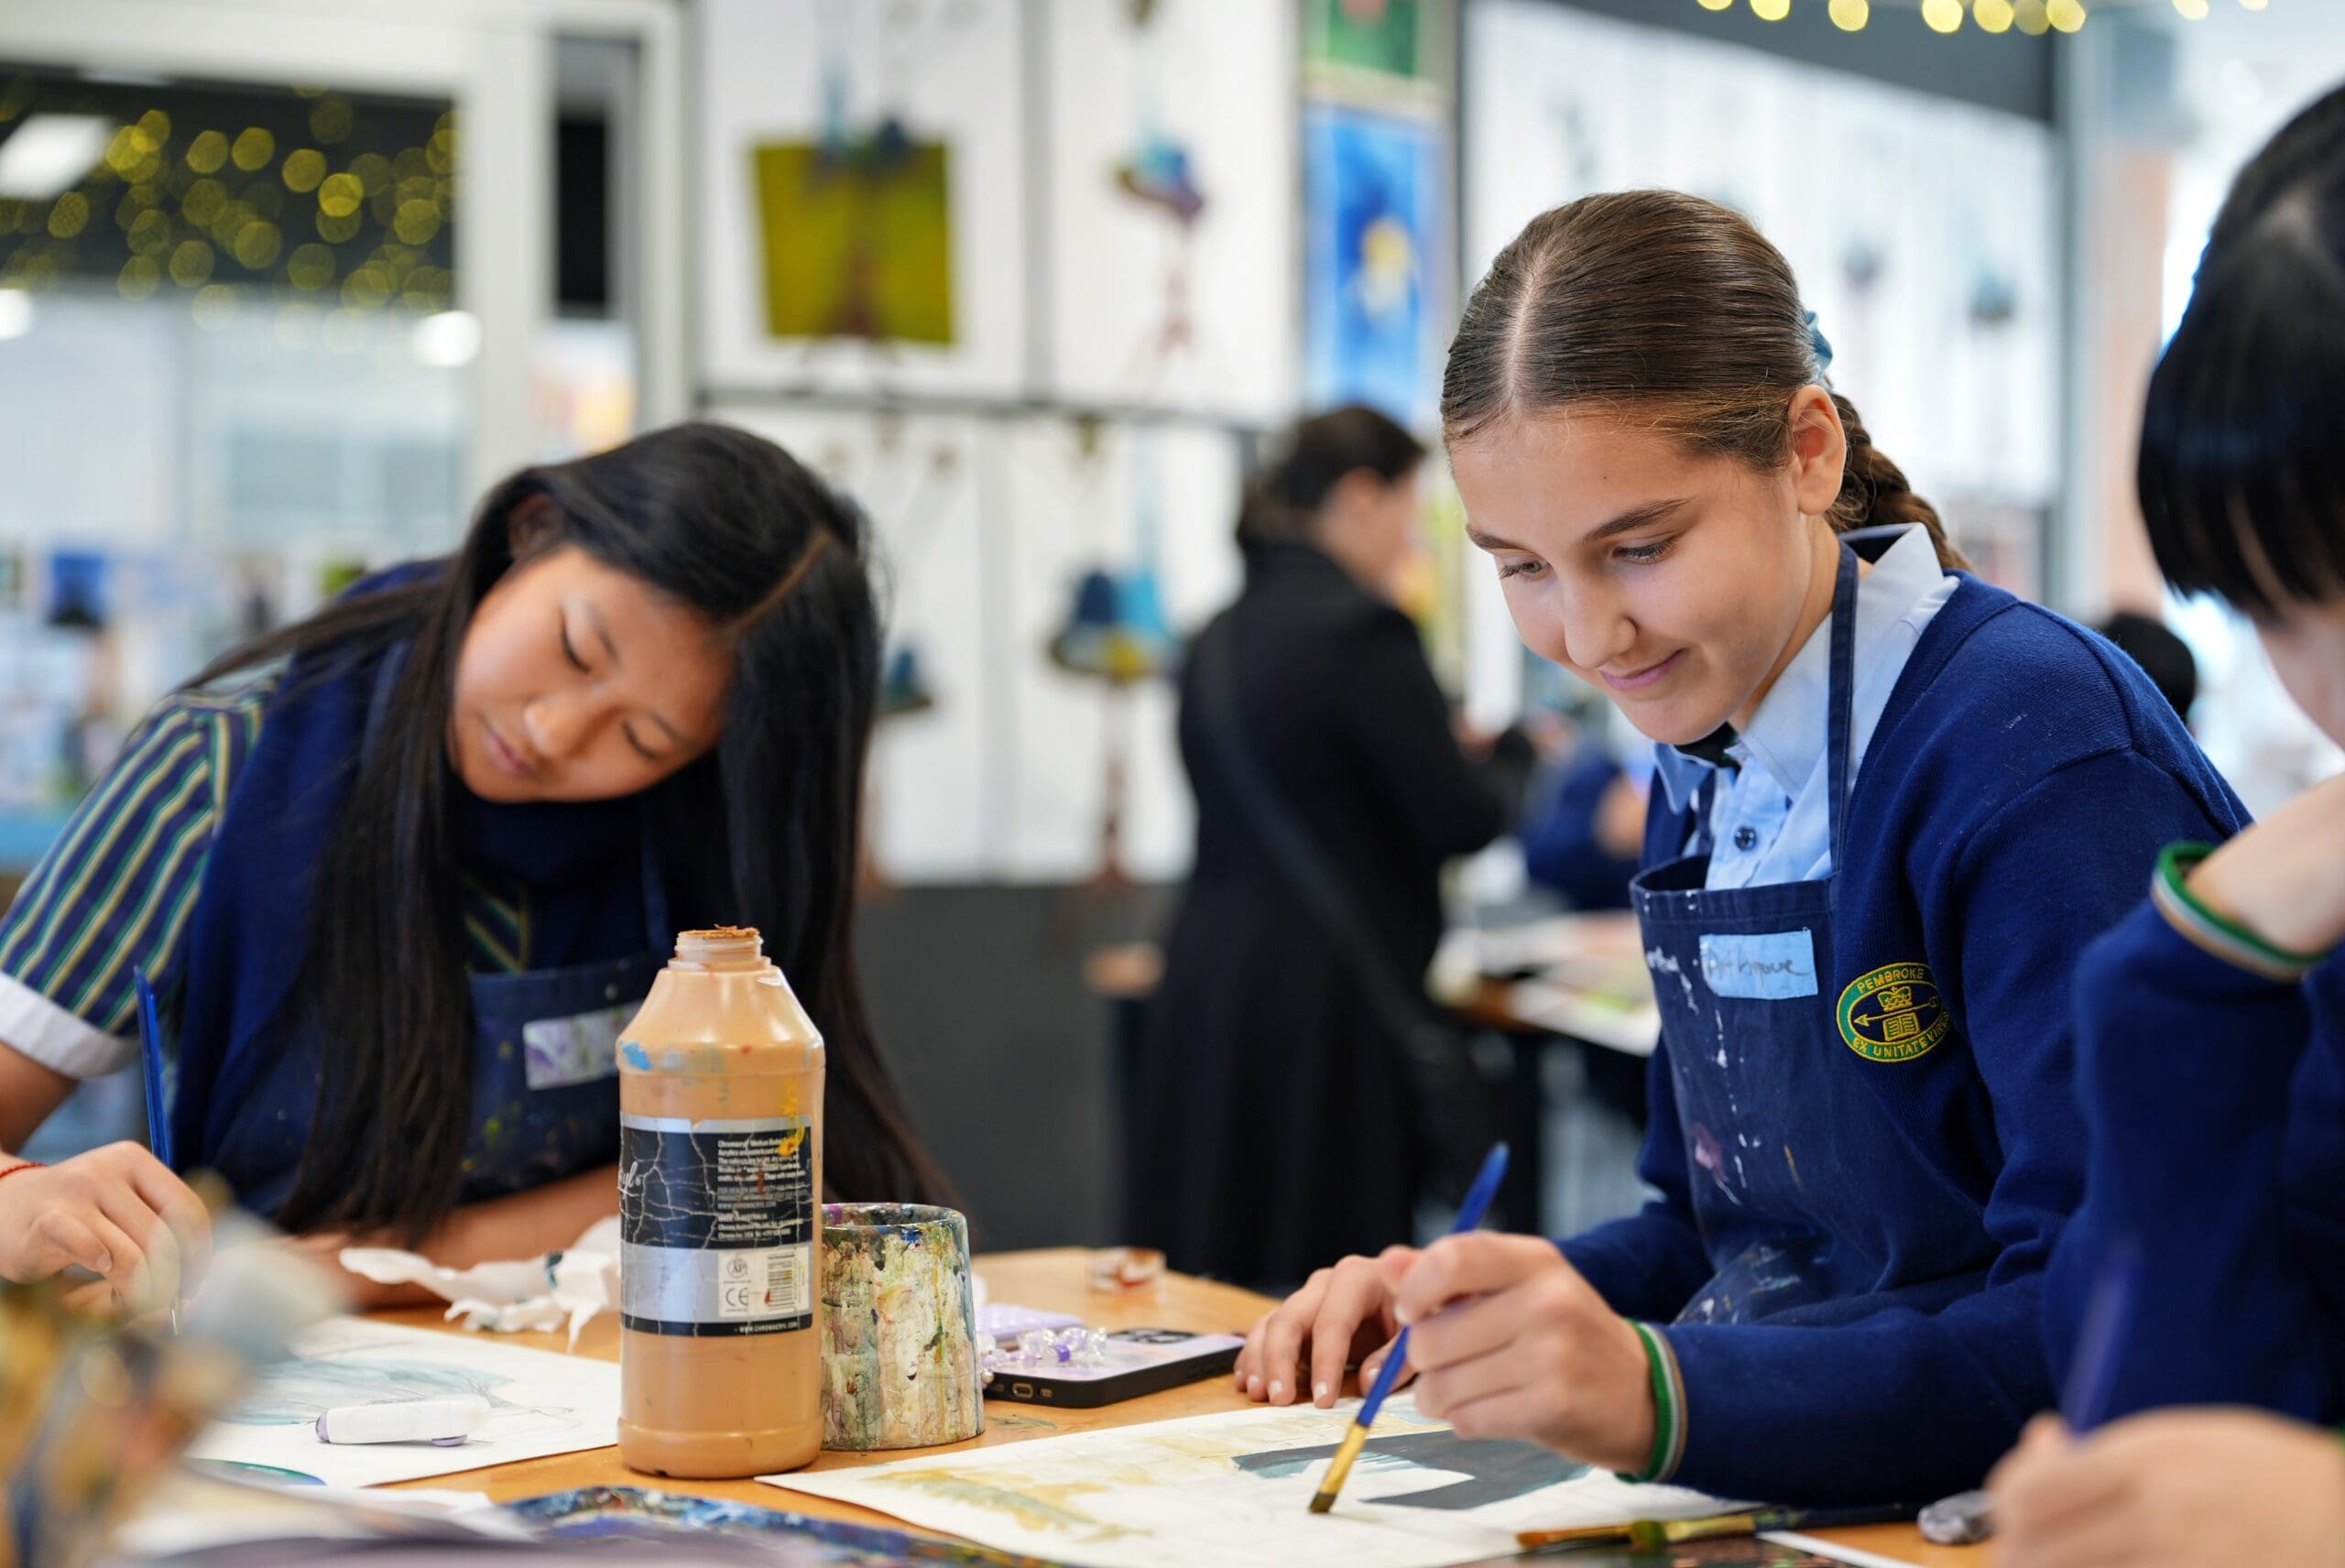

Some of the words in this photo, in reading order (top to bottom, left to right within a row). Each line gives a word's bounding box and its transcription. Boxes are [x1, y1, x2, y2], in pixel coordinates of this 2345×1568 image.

[1857, 968, 1925, 994] PEMBROKE
[1853, 1038, 1868, 1053] EX
[1873, 1037, 1927, 1058] UNITATE
